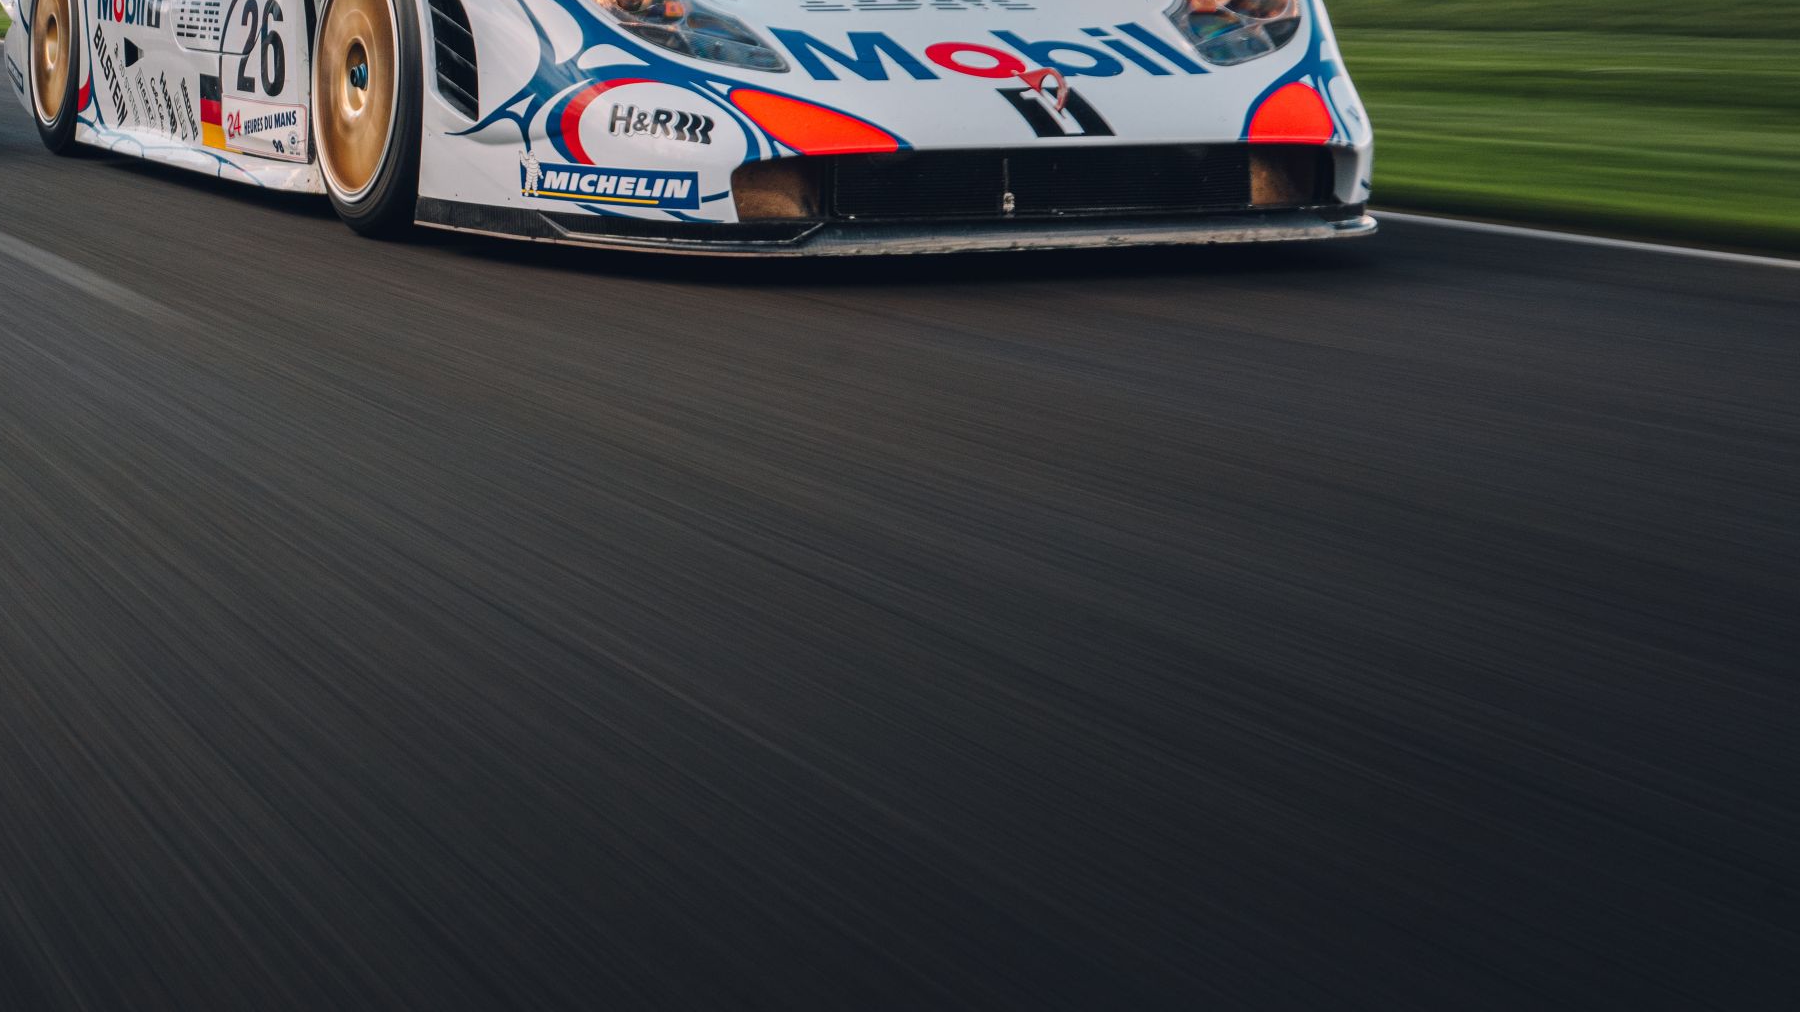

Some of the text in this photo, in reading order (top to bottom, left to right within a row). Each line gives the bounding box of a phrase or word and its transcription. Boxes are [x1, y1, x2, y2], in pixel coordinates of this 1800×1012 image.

[767, 21, 1213, 81] Mobil
[93, 22, 128, 128] BILSTEIN
[226, 108, 297, 140] 24 HEURES DU MANS
[272, 139, 285, 154] 98
[543, 170, 692, 199] MICHELIN
